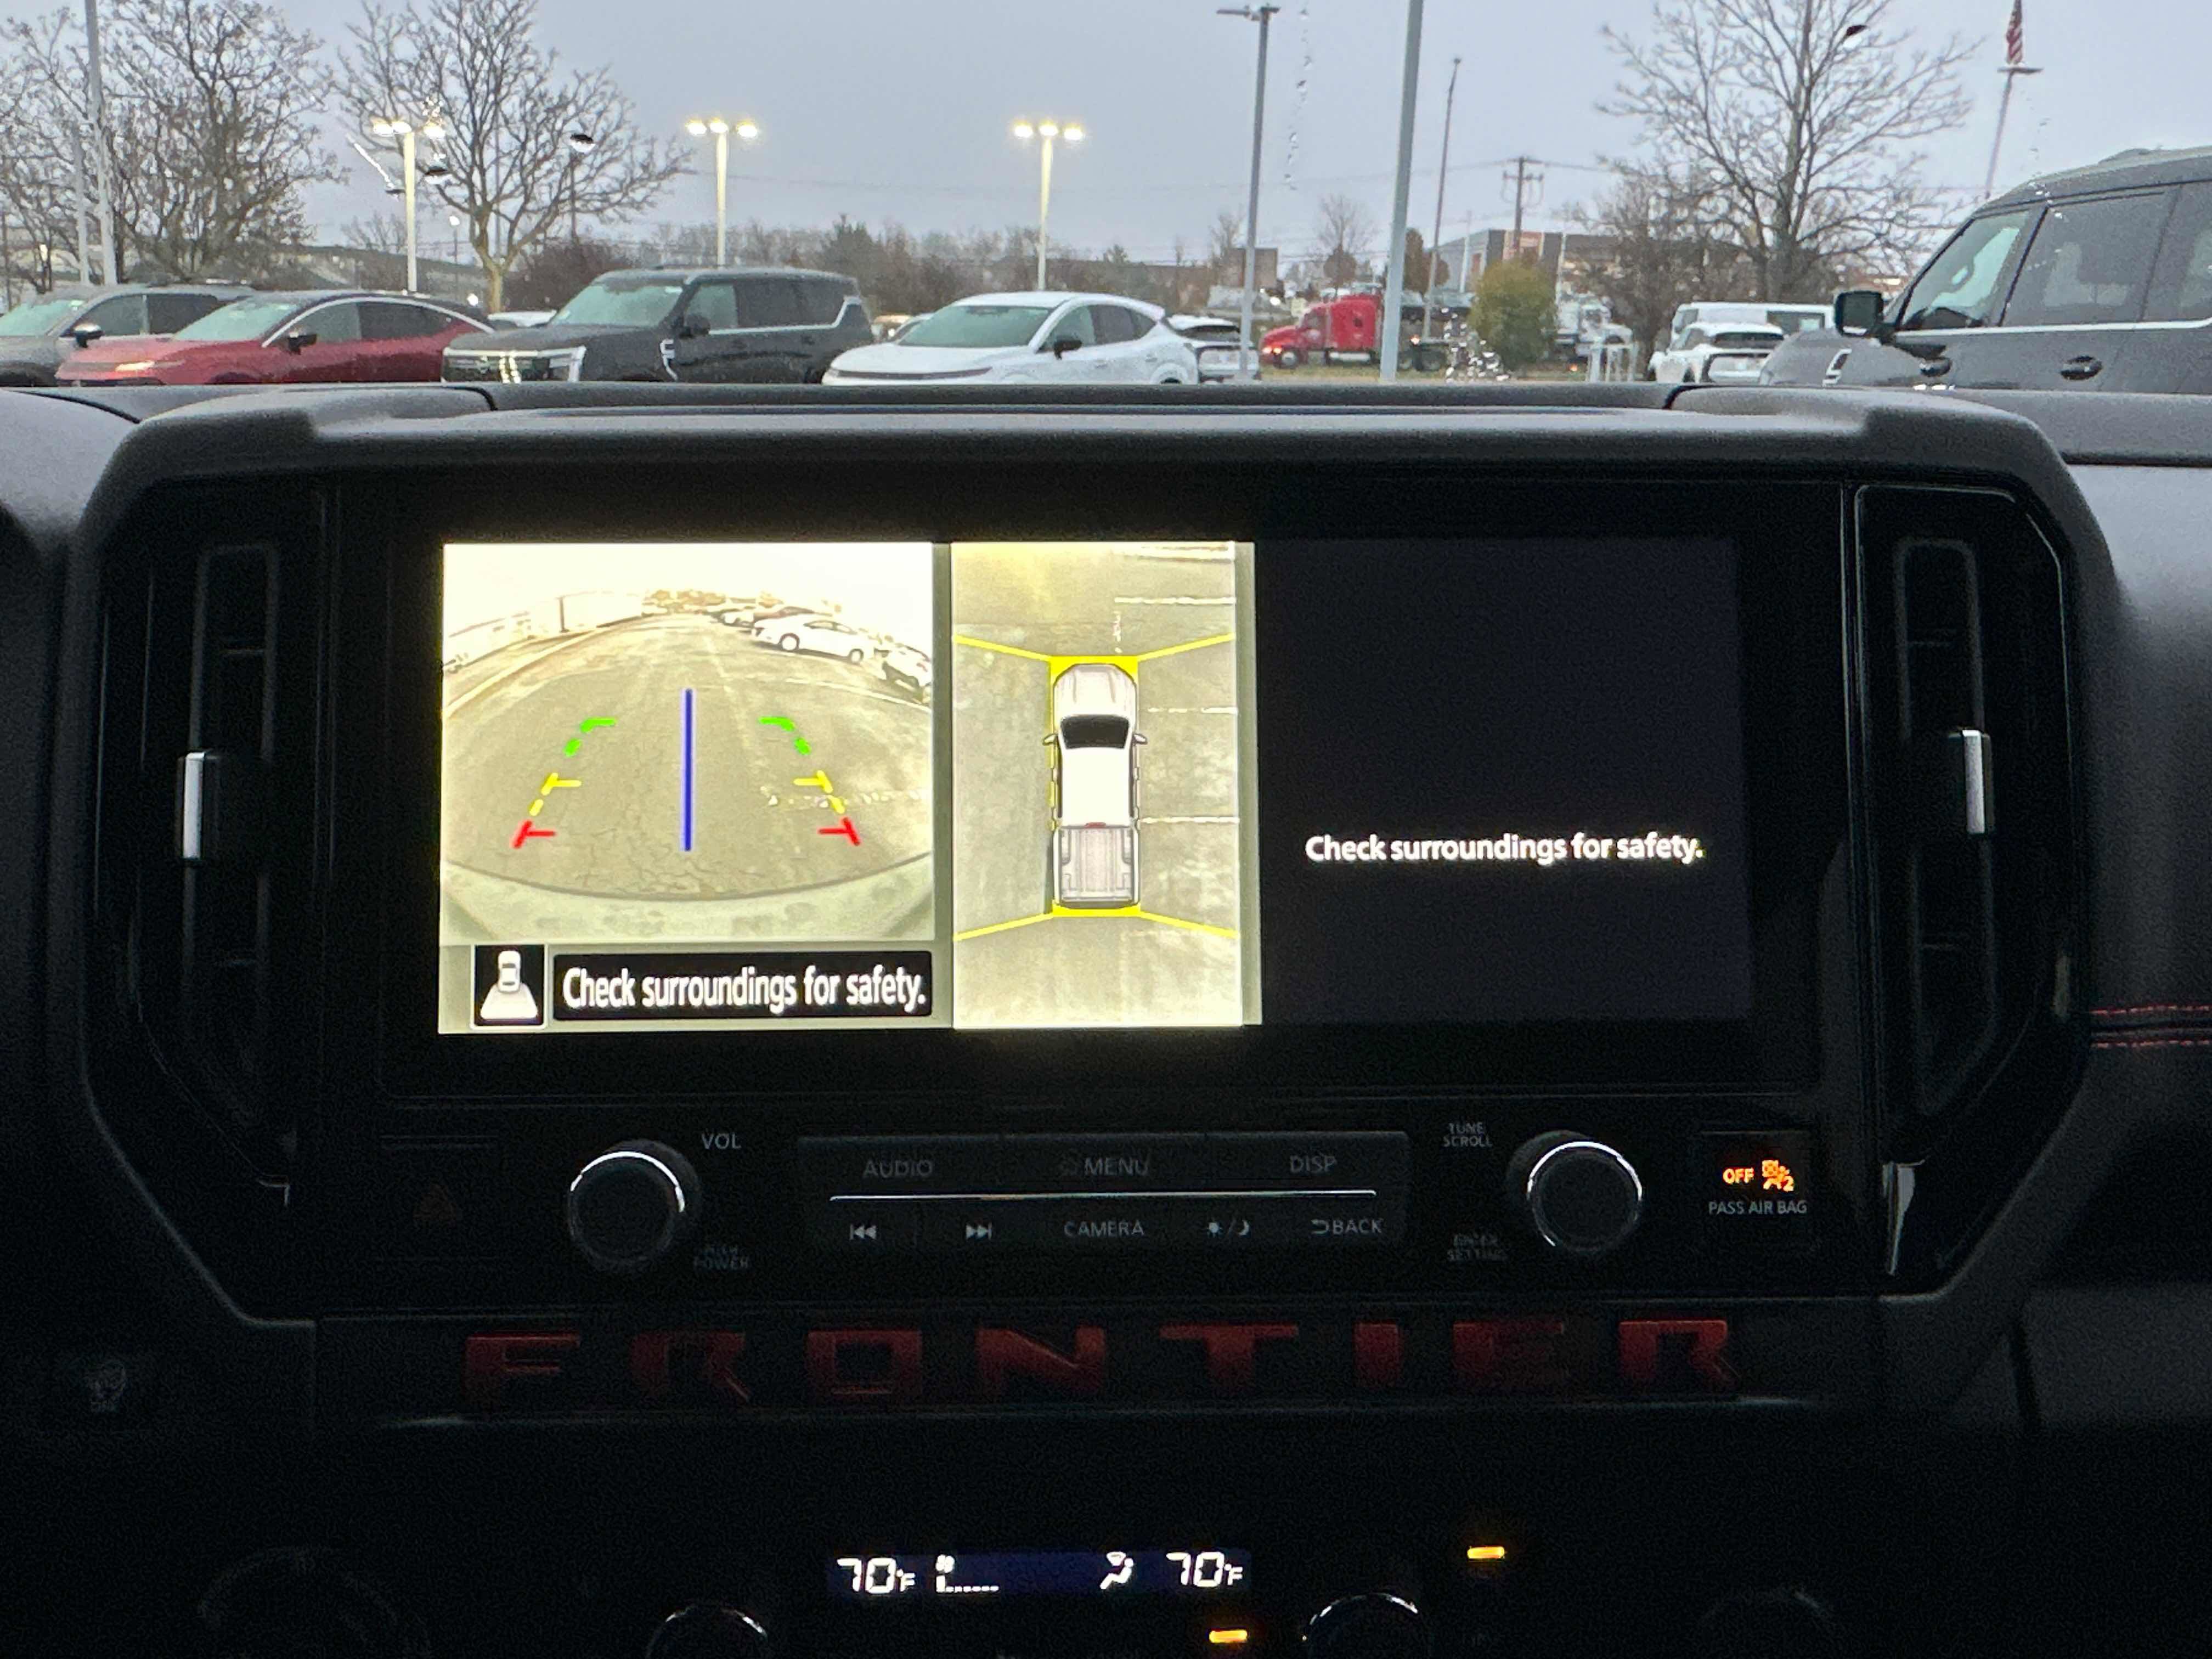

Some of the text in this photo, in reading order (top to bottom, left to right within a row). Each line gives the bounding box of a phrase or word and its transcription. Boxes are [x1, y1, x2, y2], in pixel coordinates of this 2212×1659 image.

[1305, 832, 1705, 866] Check surroundings for safety.
[562, 964, 927, 1014] Check surroundings for safety.
[701, 1132, 741, 1150] VOL
[1442, 1135, 1493, 1148] SCROLL
[862, 1158, 934, 1179] AUDIO
[1083, 1155, 1151, 1177] MENU
[1289, 1153, 1338, 1173] DISP
[1722, 1167, 1754, 1185] OFF
[1708, 1199, 1808, 1215] PASS AIR BAG
[1063, 1220, 1145, 1238] CAMERA
[1333, 1218, 1383, 1235] BACK
[462, 1318, 1737, 1406] FRONTIER
